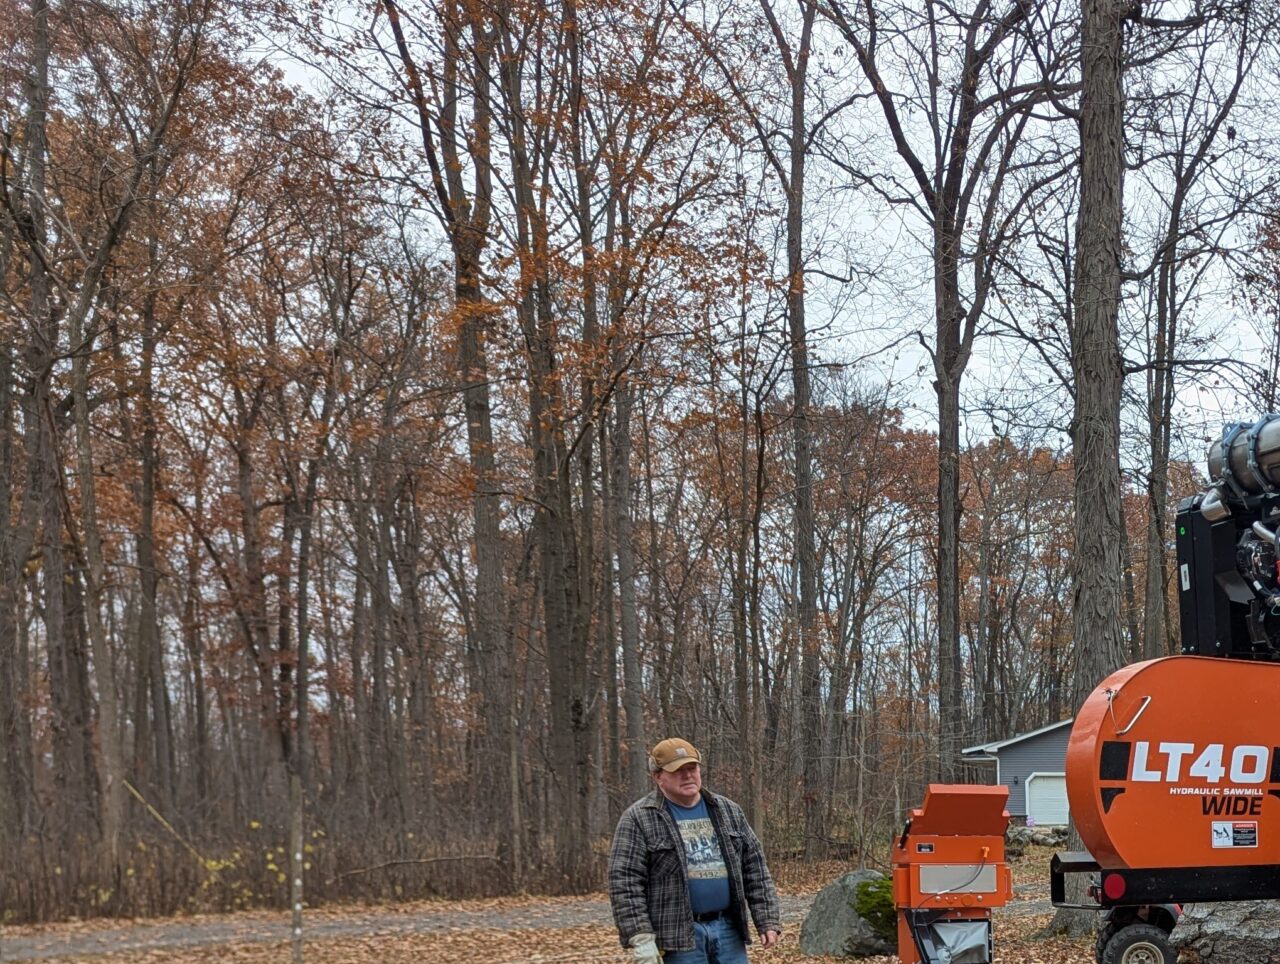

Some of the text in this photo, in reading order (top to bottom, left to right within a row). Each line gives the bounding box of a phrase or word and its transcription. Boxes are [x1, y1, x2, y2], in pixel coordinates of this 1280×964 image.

[1131, 741, 1270, 784] LT40
[1169, 787, 1264, 796] HYDRAULIC SAWMILL
[1201, 796, 1264, 816] WIDE
